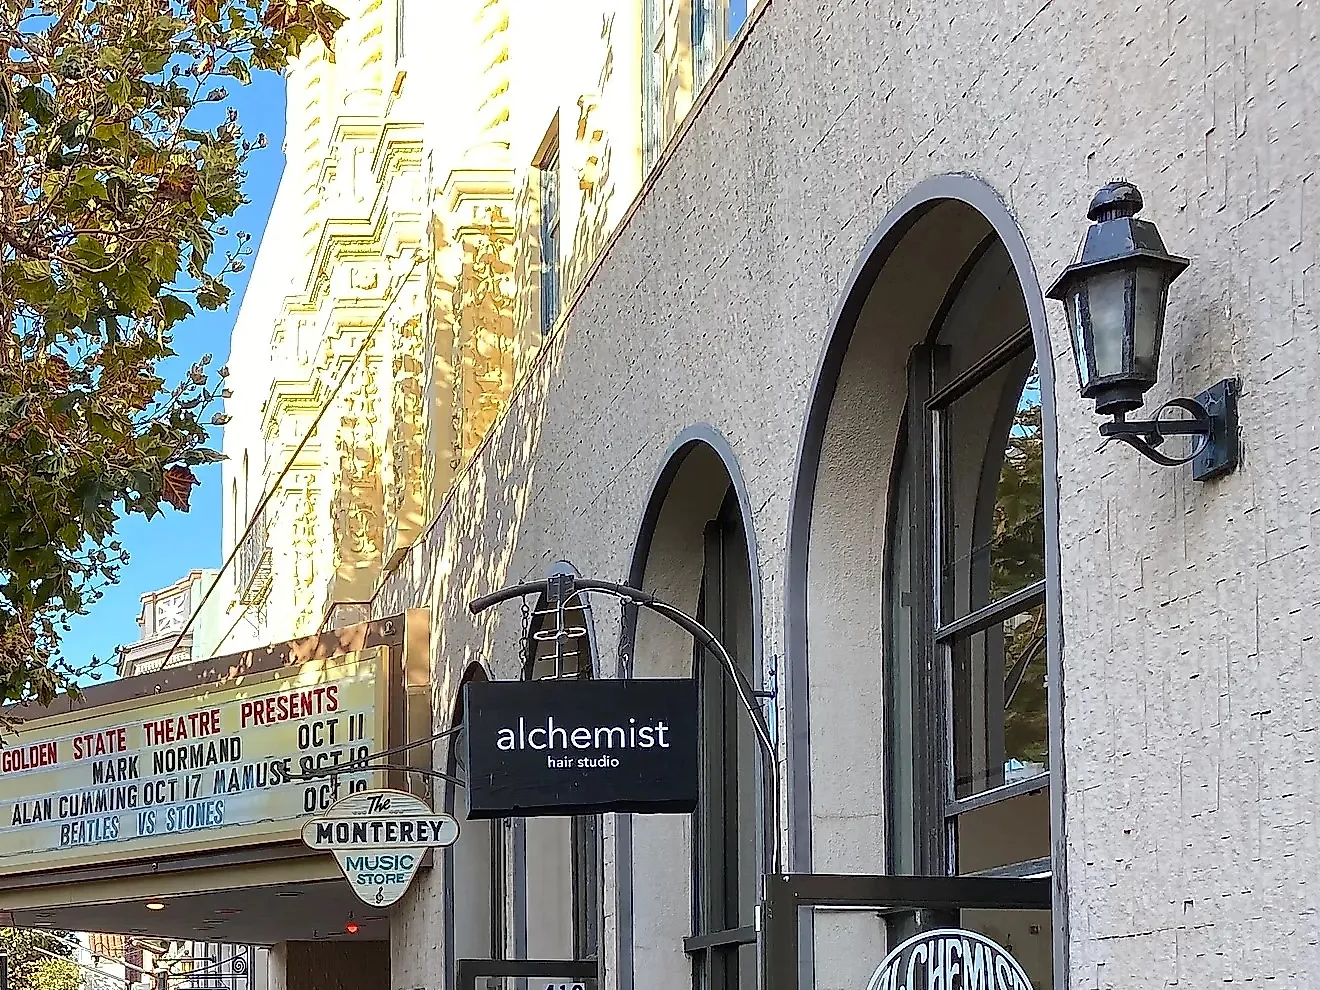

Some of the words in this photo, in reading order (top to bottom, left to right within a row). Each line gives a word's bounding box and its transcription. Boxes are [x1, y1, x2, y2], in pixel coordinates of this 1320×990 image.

[2, 741, 57, 773] GOLDEN
[73, 728, 126, 760] STATE
[143, 709, 220, 747] THEATRE
[241, 685, 338, 728] PRESENTS
[496, 716, 670, 750] alchemist
[92, 755, 139, 785] MARK
[153, 737, 241, 775] NORMAND
[299, 719, 338, 750] OCT
[547, 755, 573, 768] hair
[577, 754, 619, 768] studio
[12, 798, 52, 826] ALAN
[59, 784, 138, 818] CUMMING
[143, 778, 177, 805] OCT
[184, 773, 201, 799] 17
[367, 794, 391, 814] The
[59, 816, 119, 846] BEATLES
[138, 811, 156, 835] VS
[166, 801, 224, 831] STONES
[316, 820, 443, 844] MONTEREY
[346, 855, 414, 871] MUSIC
[357, 873, 405, 884] STORE
